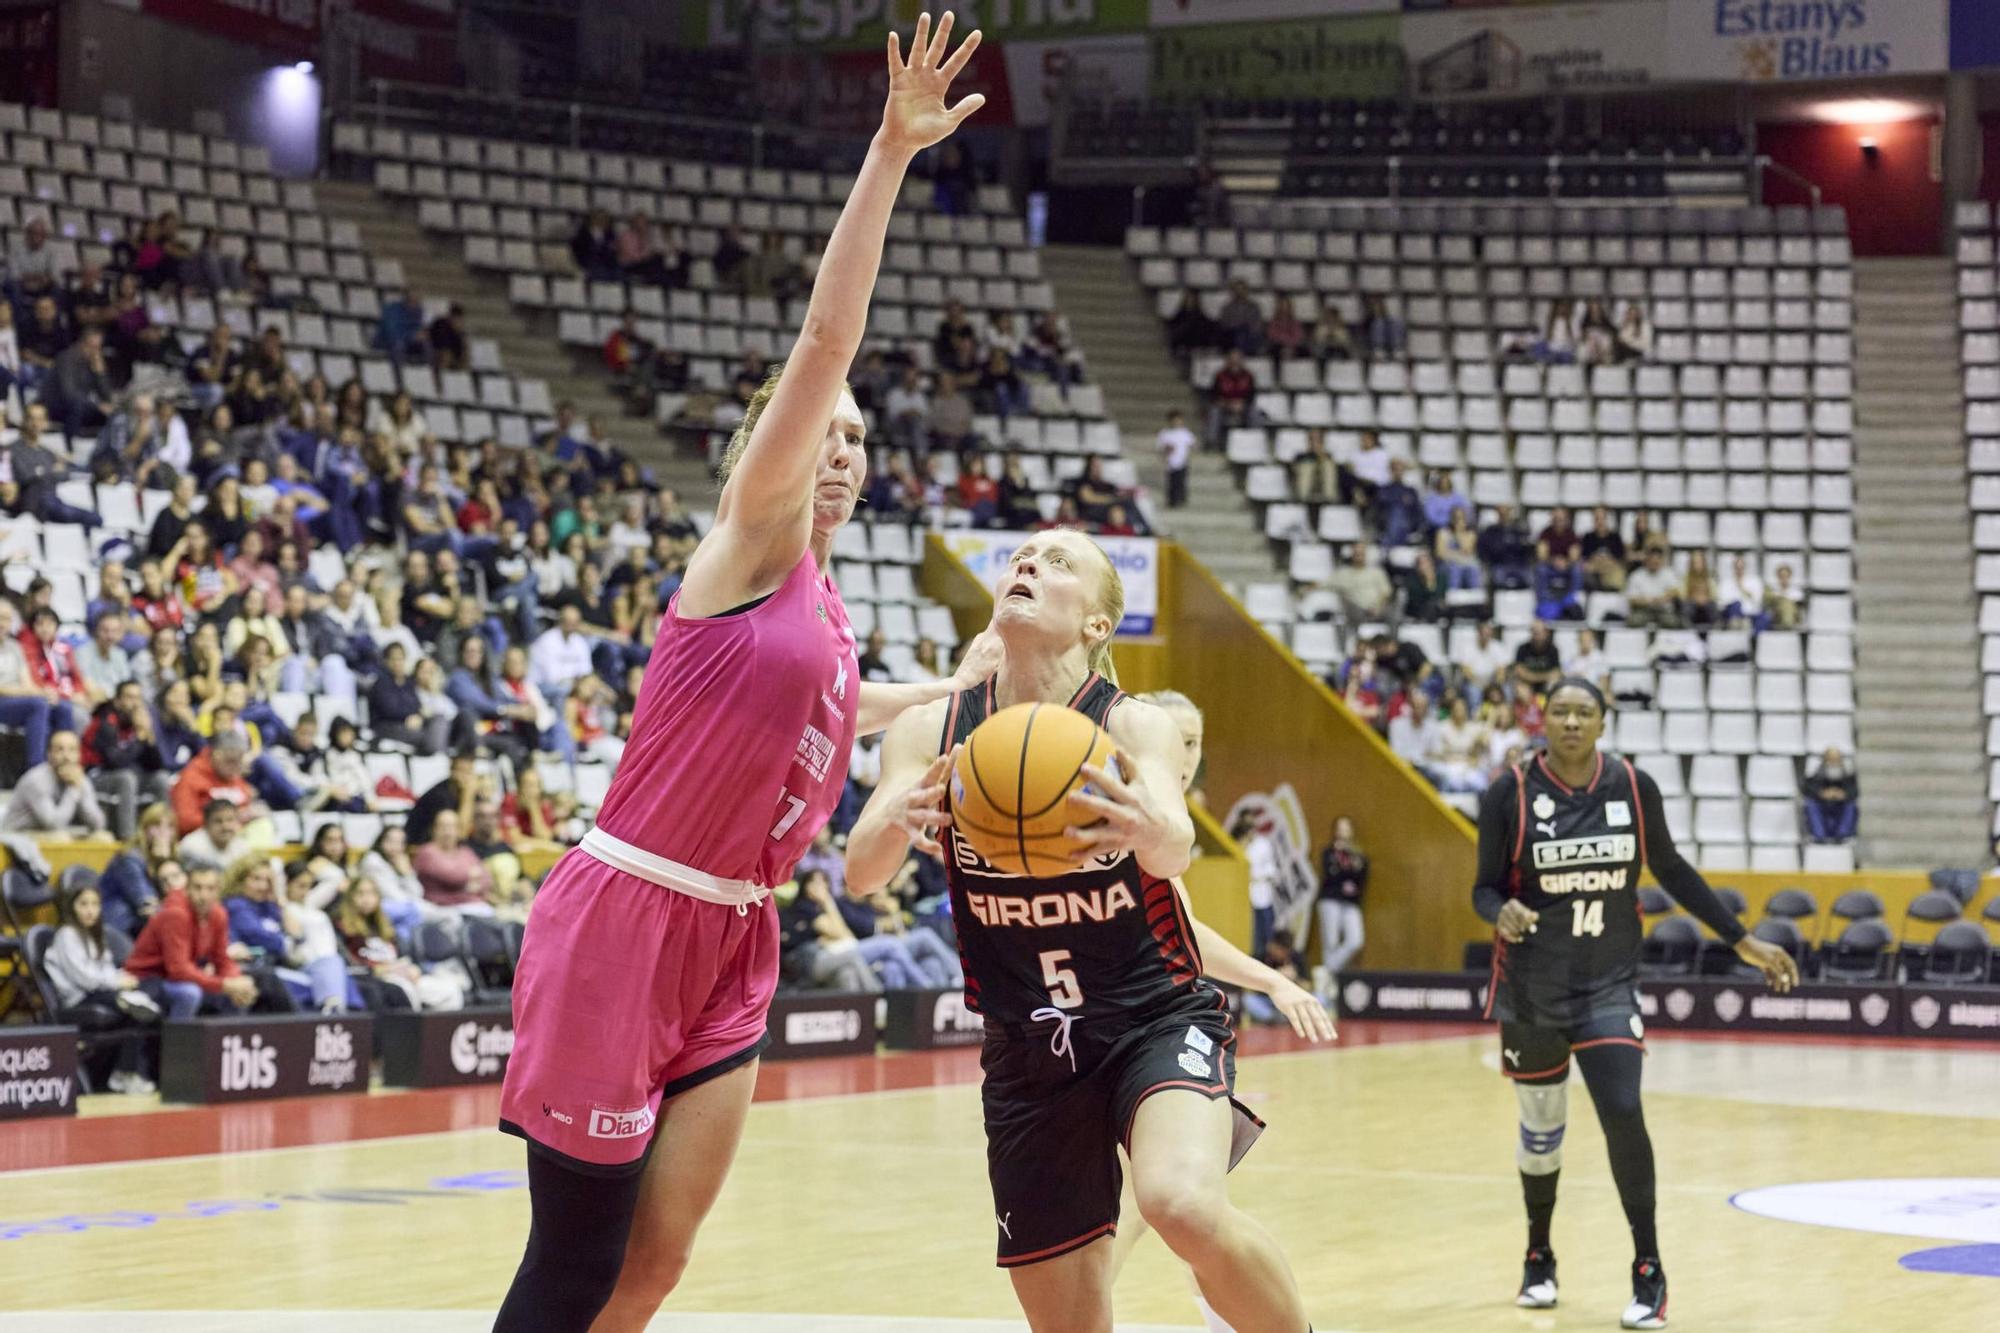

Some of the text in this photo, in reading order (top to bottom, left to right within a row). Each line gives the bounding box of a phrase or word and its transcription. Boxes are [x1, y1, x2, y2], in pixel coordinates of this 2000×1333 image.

[1715, 0, 1867, 38] Estanys
[1781, 38, 1891, 77] Blaus
[1541, 842, 1613, 864] SPAR
[967, 880, 1136, 927] GIRONA
[1572, 899, 1605, 937] 14
[1039, 949, 1083, 1009] 5
[315, 1023, 353, 1061] ibis
[220, 1033, 277, 1091] ibis
